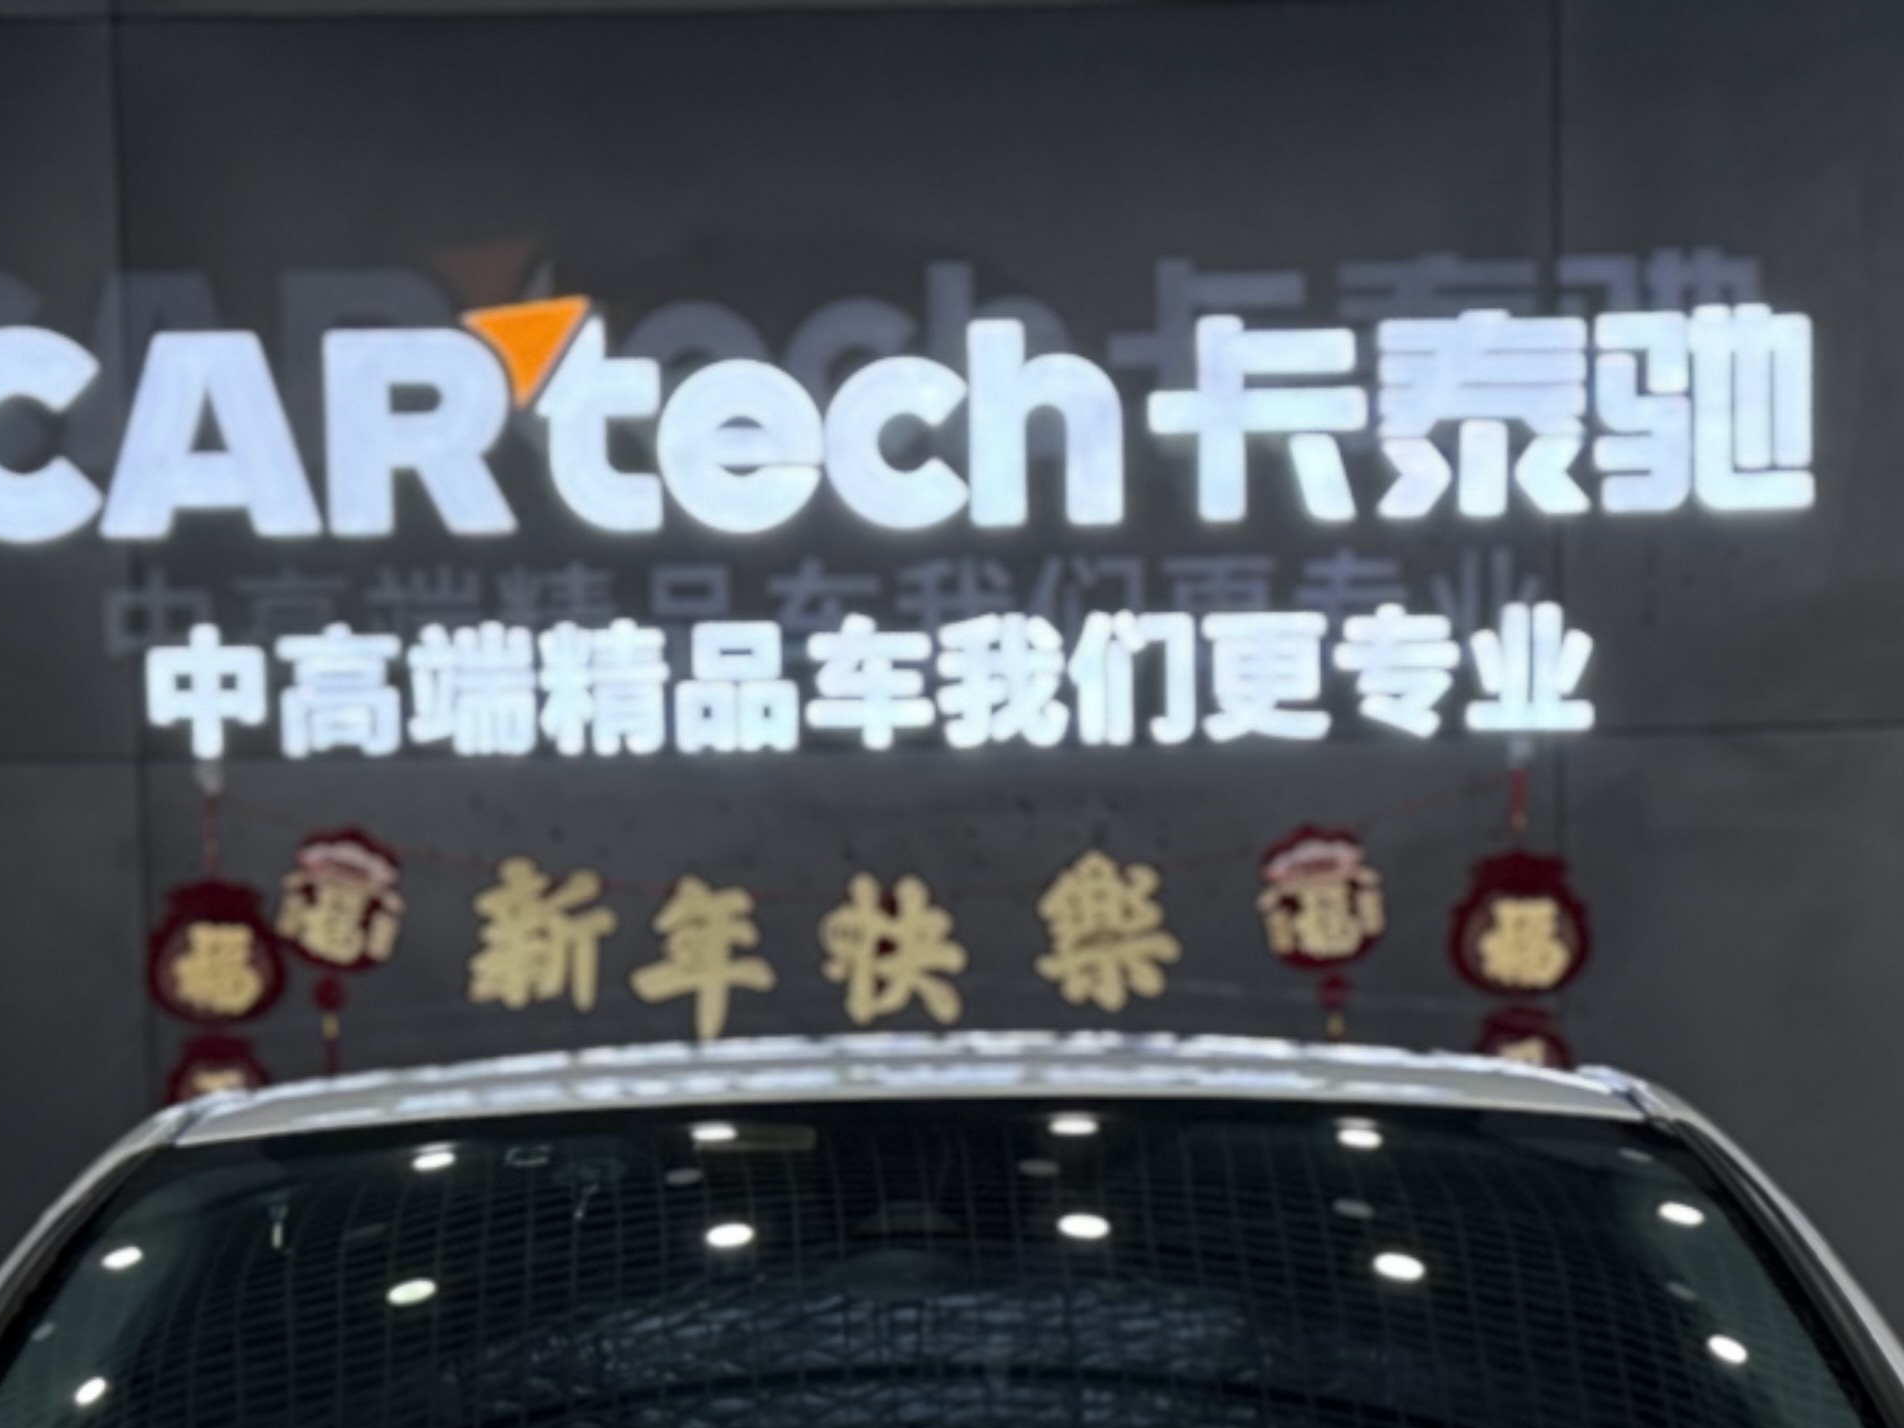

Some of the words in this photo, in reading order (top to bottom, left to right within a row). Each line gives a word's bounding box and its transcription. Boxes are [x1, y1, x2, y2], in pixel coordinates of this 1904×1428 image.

[1146, 303, 1815, 523] 卡泰驰
[145, 602, 1595, 758] 中高端精品车我们更专业
[467, 850, 1183, 1042] 新年快樂
